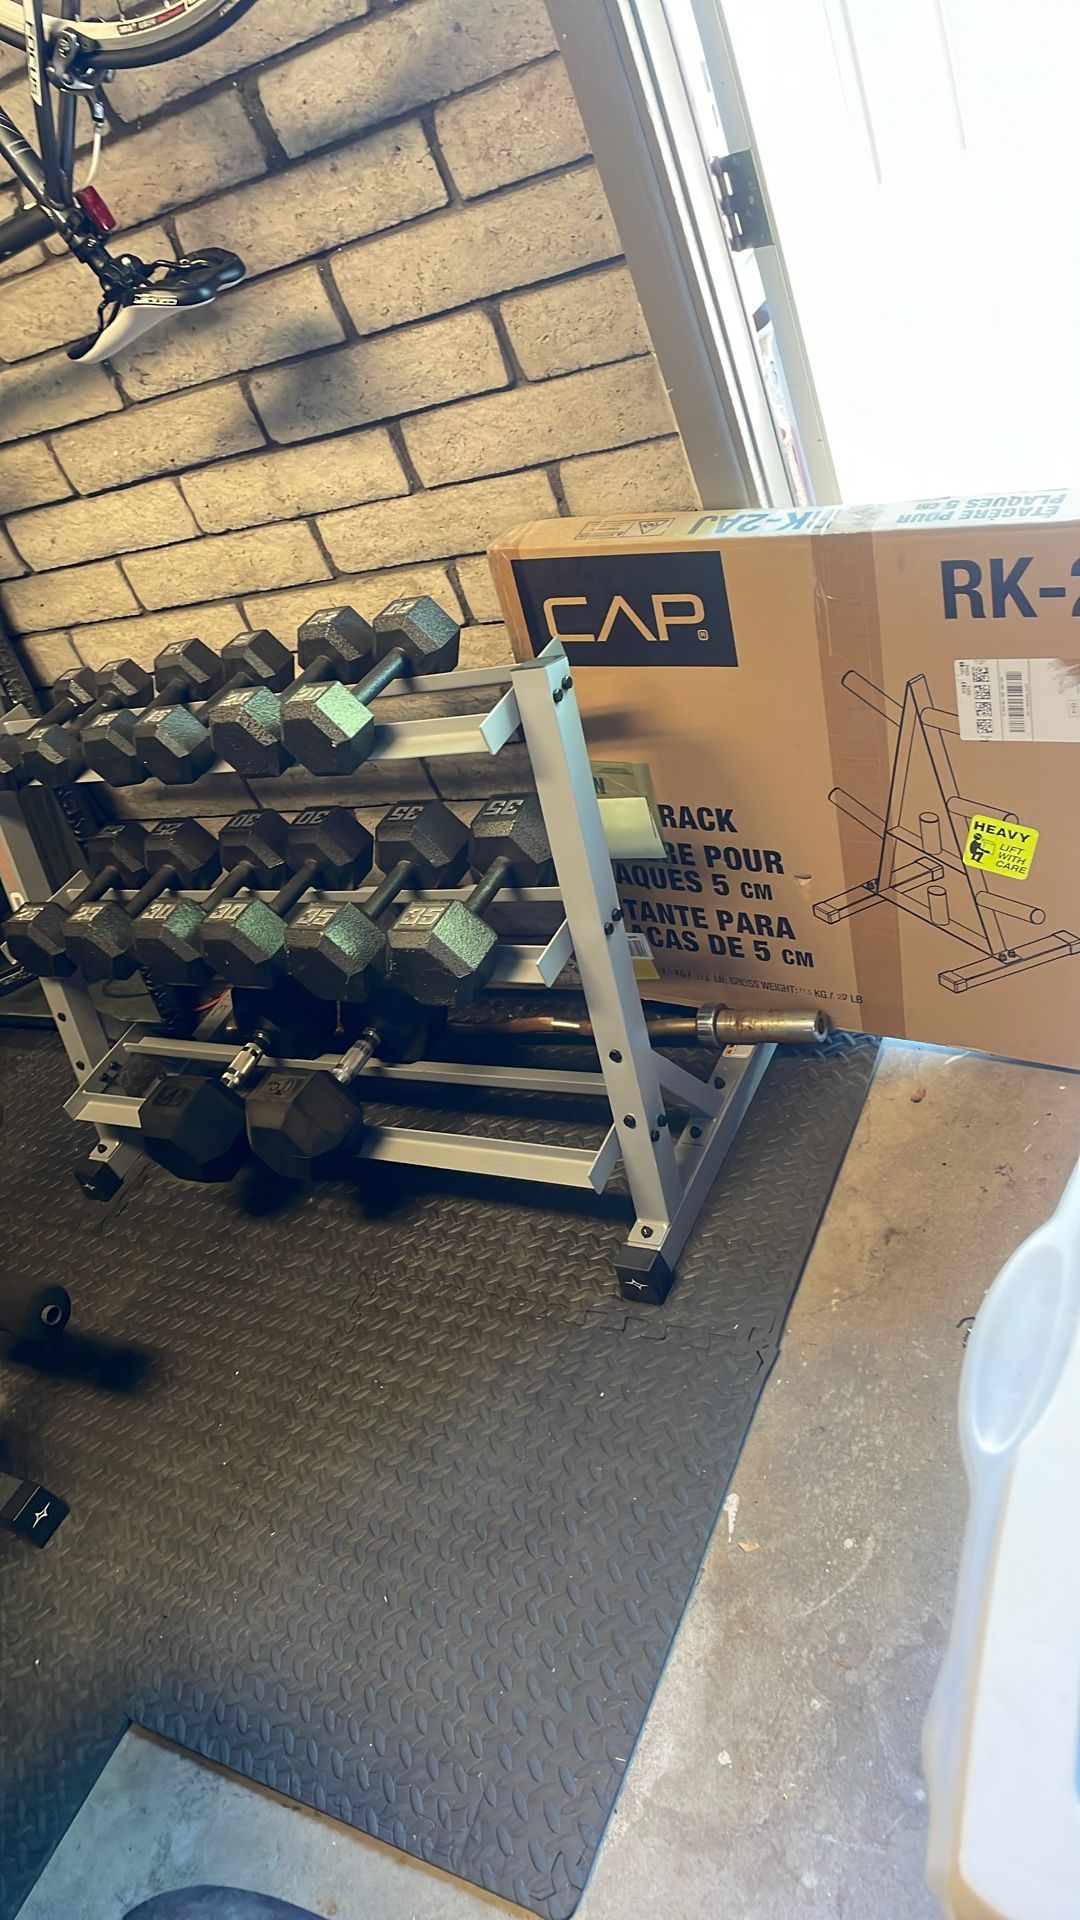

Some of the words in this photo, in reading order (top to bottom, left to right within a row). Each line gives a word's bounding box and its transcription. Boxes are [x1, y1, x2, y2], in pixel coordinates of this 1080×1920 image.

[943, 499, 957, 510] 5
[965, 493, 1067, 509] PLAQUES
[896, 511, 951, 524] POUR
[940, 557, 1080, 620] RK-
[293, 685, 327, 701] 20
[388, 806, 424, 821] 35
[484, 799, 523, 816] 35
[229, 813, 261, 828] 30
[295, 810, 330, 825] 30
[657, 803, 738, 833] RACK
[973, 821, 1031, 843] HEAVY
[999, 843, 1025, 855] LIFT
[703, 845, 785, 875] POUR
[995, 860, 1028, 874] CARE
[998, 852, 1027, 865] WITH
[615, 862, 703, 893] AQUES
[712, 873, 730, 897] 5
[141, 903, 177, 920] 30
[209, 903, 248, 920] 30
[297, 907, 338, 926] 35
[400, 906, 445, 926] 35
[622, 898, 709, 930] TANTE
[716, 909, 797, 941] PARA
[707, 933, 745, 959] DE
[752, 940, 771, 963] 5
[729, 976, 759, 989] GROSS
[760, 981, 798, 994] WEIGHT:
[814, 989, 827, 999] KG
[850, 993, 863, 1004] LB
